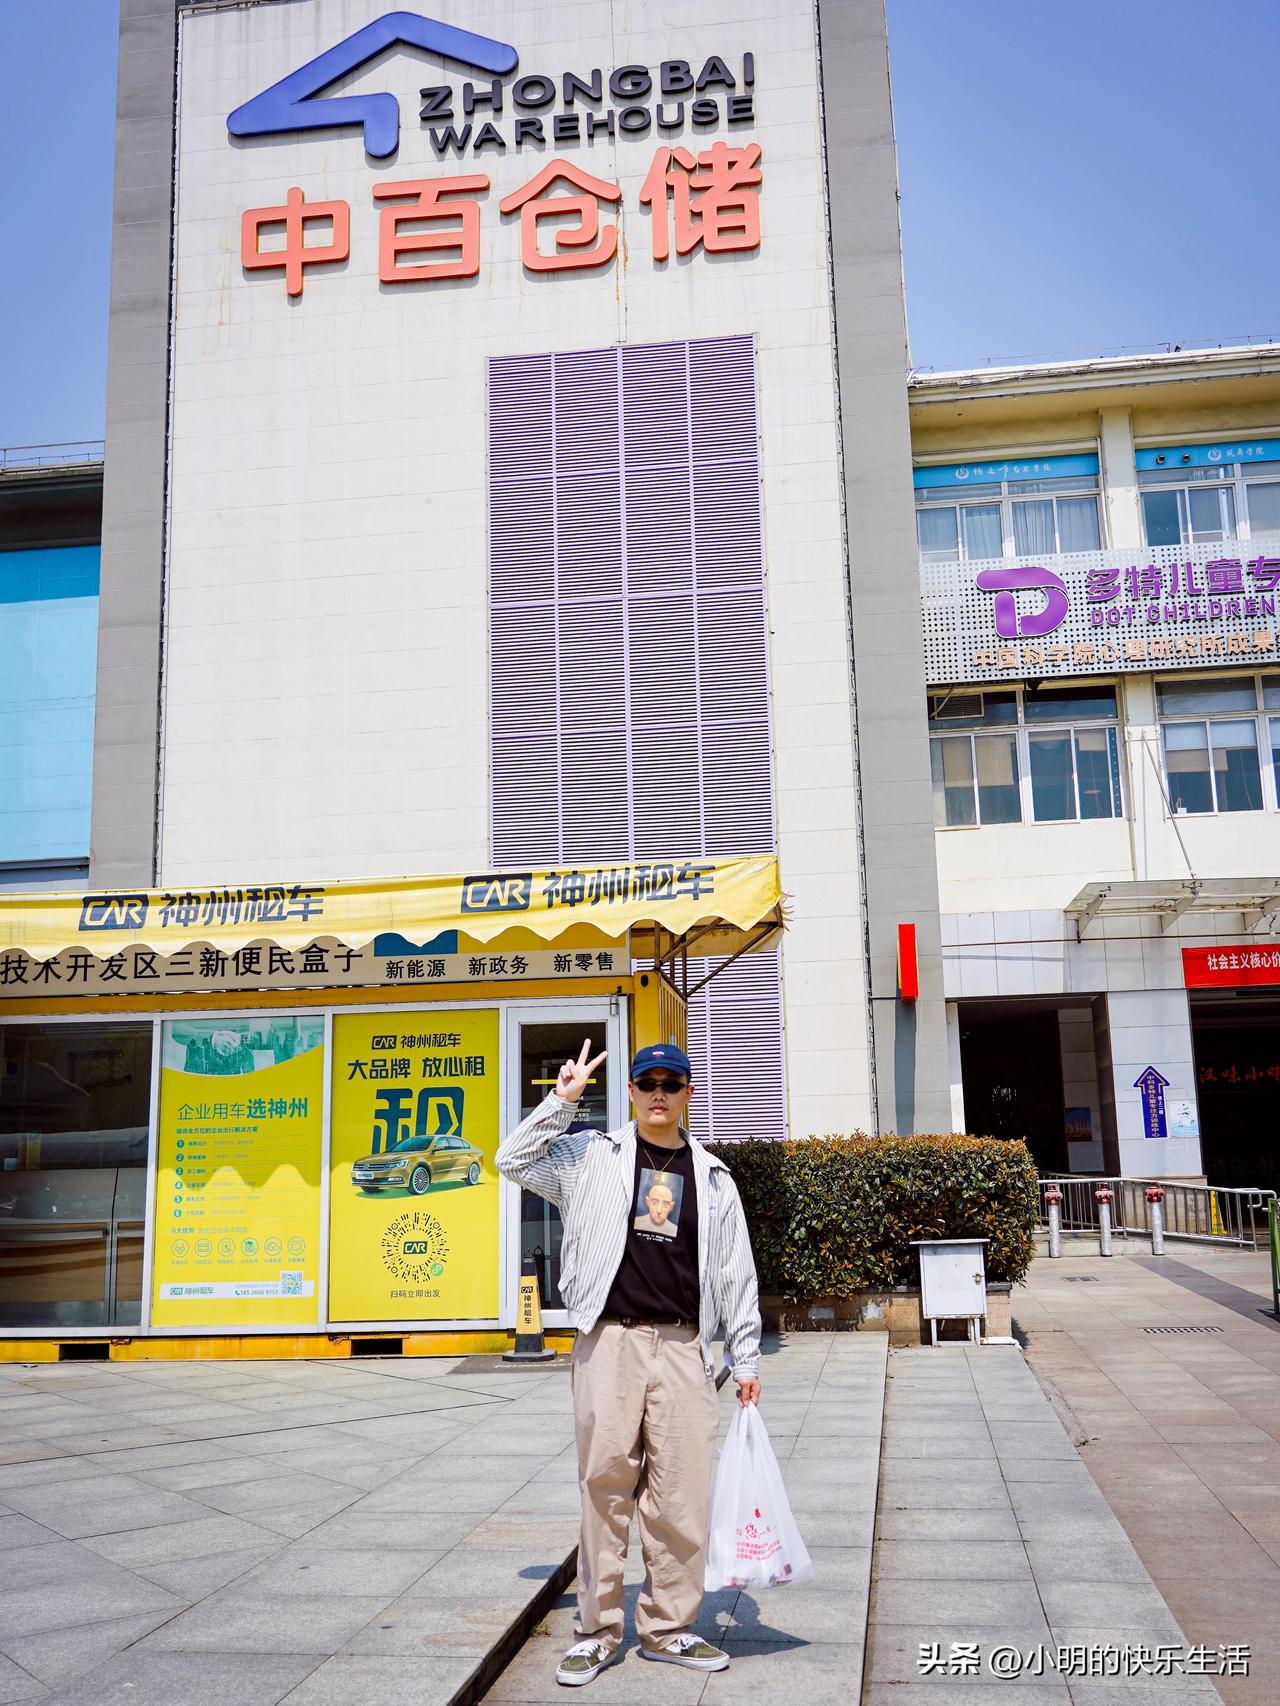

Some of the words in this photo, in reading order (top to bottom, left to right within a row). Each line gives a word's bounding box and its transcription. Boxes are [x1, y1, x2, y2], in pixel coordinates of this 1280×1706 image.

[419, 51, 756, 121] ZHONGBAI
[429, 95, 756, 152] WAREHOUSE
[241, 141, 763, 297] 中百仓储
[1087, 556, 1280, 602] 多特儿童专
[1091, 607, 1136, 627] DOT
[1147, 597, 1276, 623] CHILDREN
[972, 630, 1280, 672] 中国科学院心理研究所成果
[460, 873, 533, 913] CAR
[542, 862, 716, 909] 神州租车
[79, 895, 148, 930] CAR
[159, 885, 326, 928] 神州租车
[0, 943, 363, 985] 技术开发区三新便民盒子
[386, 958, 447, 979] 新能源
[468, 954, 530, 977] 新政务
[553, 951, 614, 973] 新零售
[1207, 951, 1280, 971] 社会主义核心价
[372, 1035, 397, 1050] CAR
[401, 1033, 461, 1049] 神州租车
[348, 1058, 411, 1080] 大品牌
[422, 1056, 485, 1078] 放心租
[177, 1097, 308, 1121] 企业用车选神州
[403, 1241, 428, 1254] CAR
[184, 1287, 214, 1295] 神州租车
[390, 1289, 441, 1299] 扫码立即出发
[523, 1295, 532, 1325] 神州租车
